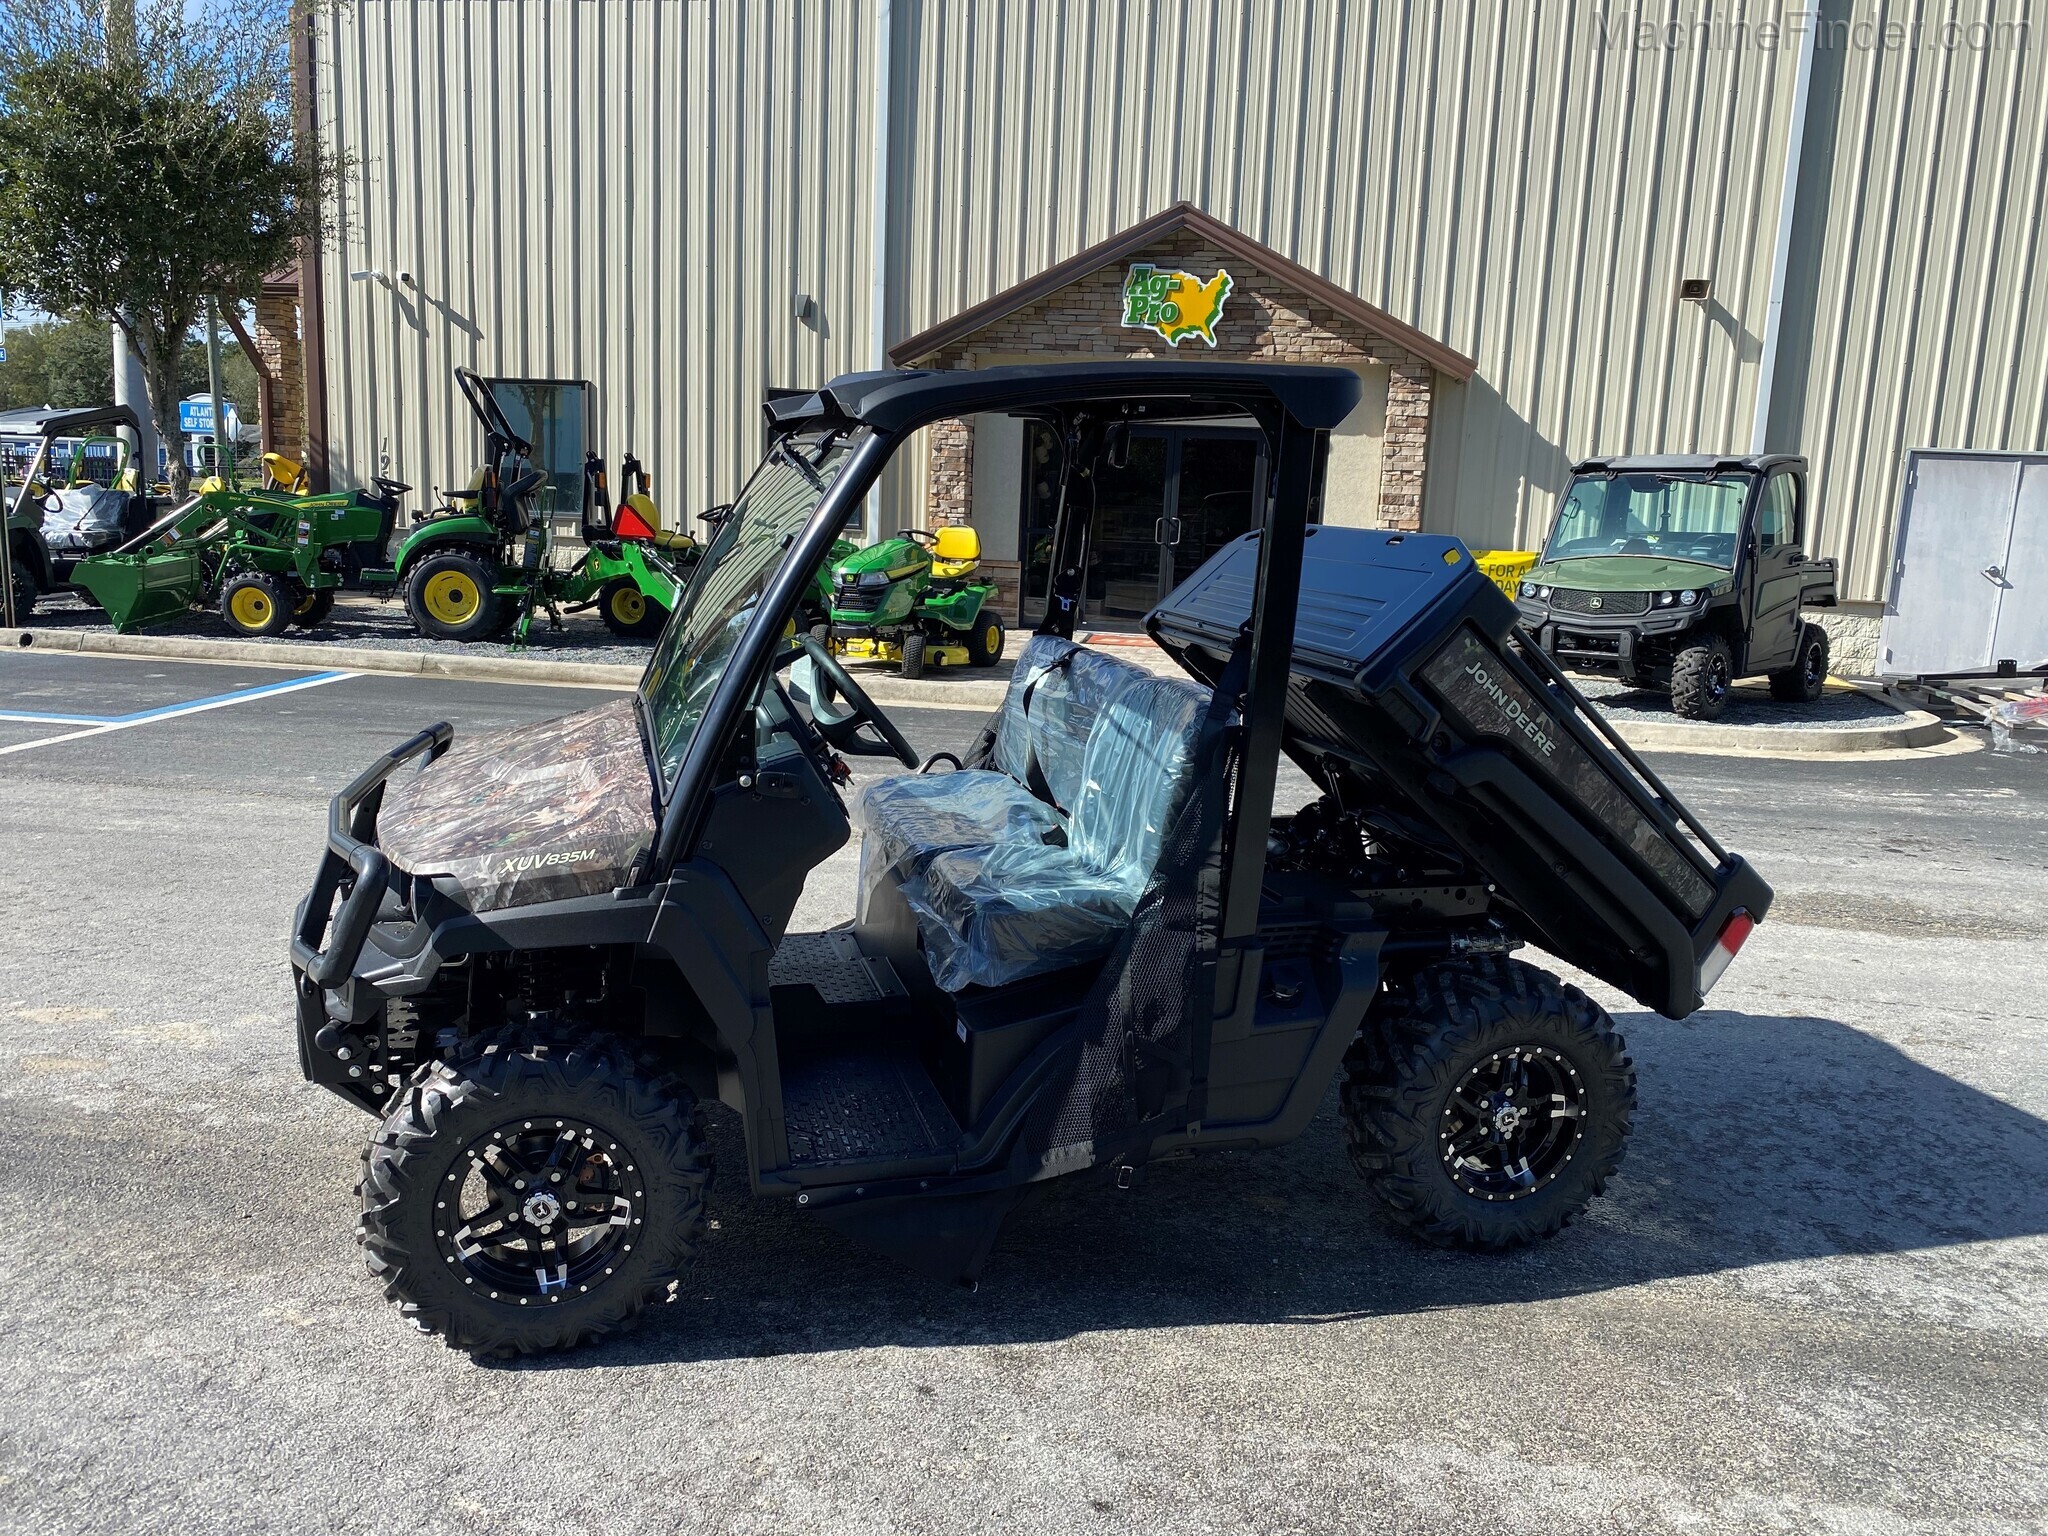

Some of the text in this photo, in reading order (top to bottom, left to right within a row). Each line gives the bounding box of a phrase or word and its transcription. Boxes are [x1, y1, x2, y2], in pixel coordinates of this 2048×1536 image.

[1126, 267, 1180, 302] Ag-
[1124, 295, 1180, 324] Pro
[183, 417, 215, 429] SELF STOR
[189, 405, 213, 417] ATLANT
[1488, 563, 1515, 578] FOR
[1517, 565, 1526, 578] A
[1464, 661, 1557, 757] JOHN DEERE
[499, 848, 597, 875] XUV835M
